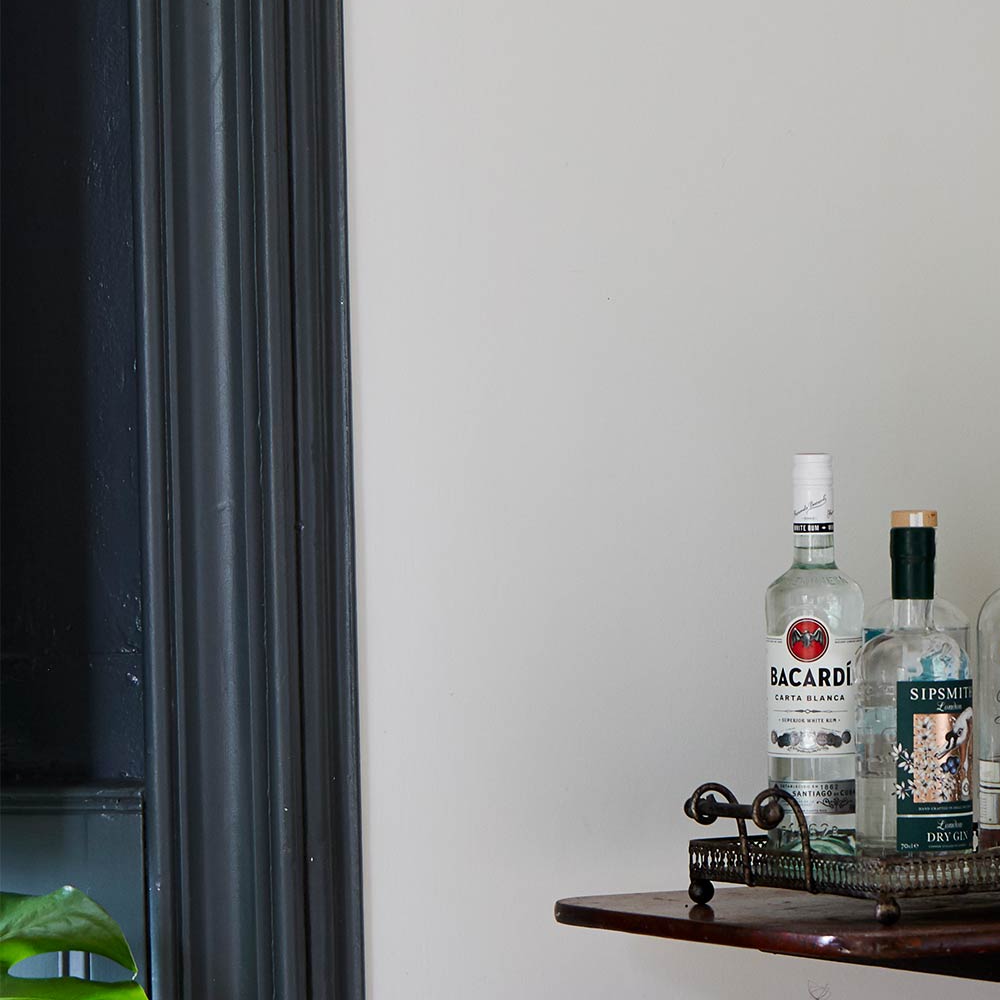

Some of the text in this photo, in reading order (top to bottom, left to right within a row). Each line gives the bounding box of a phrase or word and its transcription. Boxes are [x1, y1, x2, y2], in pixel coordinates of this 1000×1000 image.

[771, 660, 851, 687] BACARDÍ
[927, 831, 968, 842] DRY GIN
